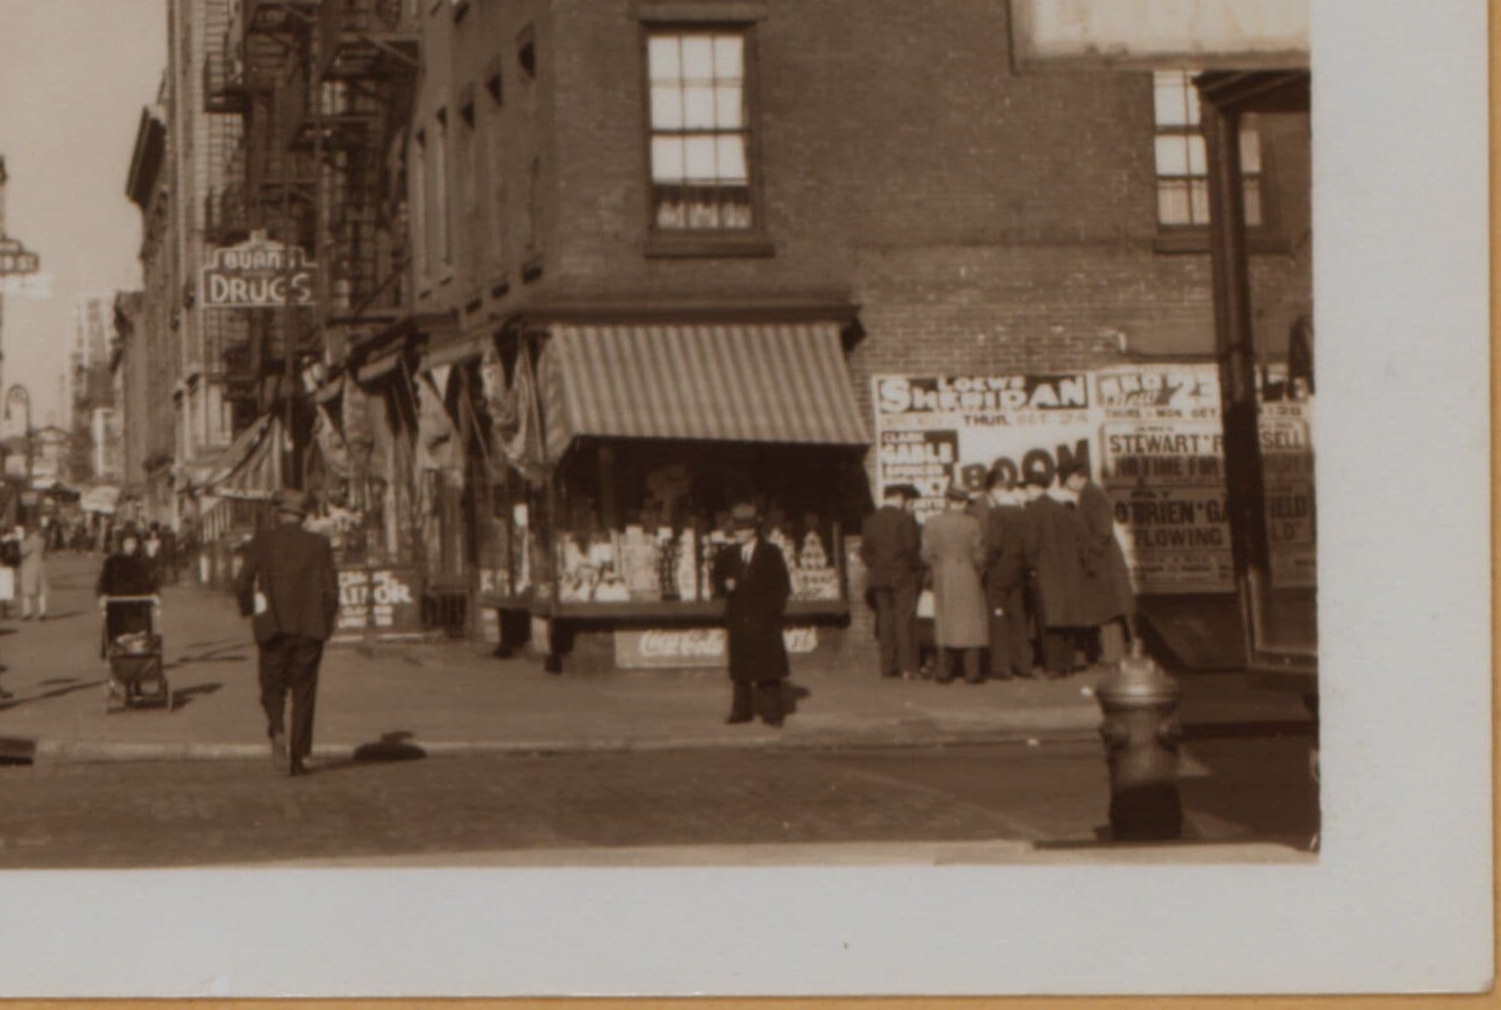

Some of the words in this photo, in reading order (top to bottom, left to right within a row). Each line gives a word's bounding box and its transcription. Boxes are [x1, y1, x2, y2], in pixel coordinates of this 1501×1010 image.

[210, 273, 312, 304] DRUGS
[1109, 433, 1200, 454] STEWART
[961, 439, 1091, 492] BOOM
